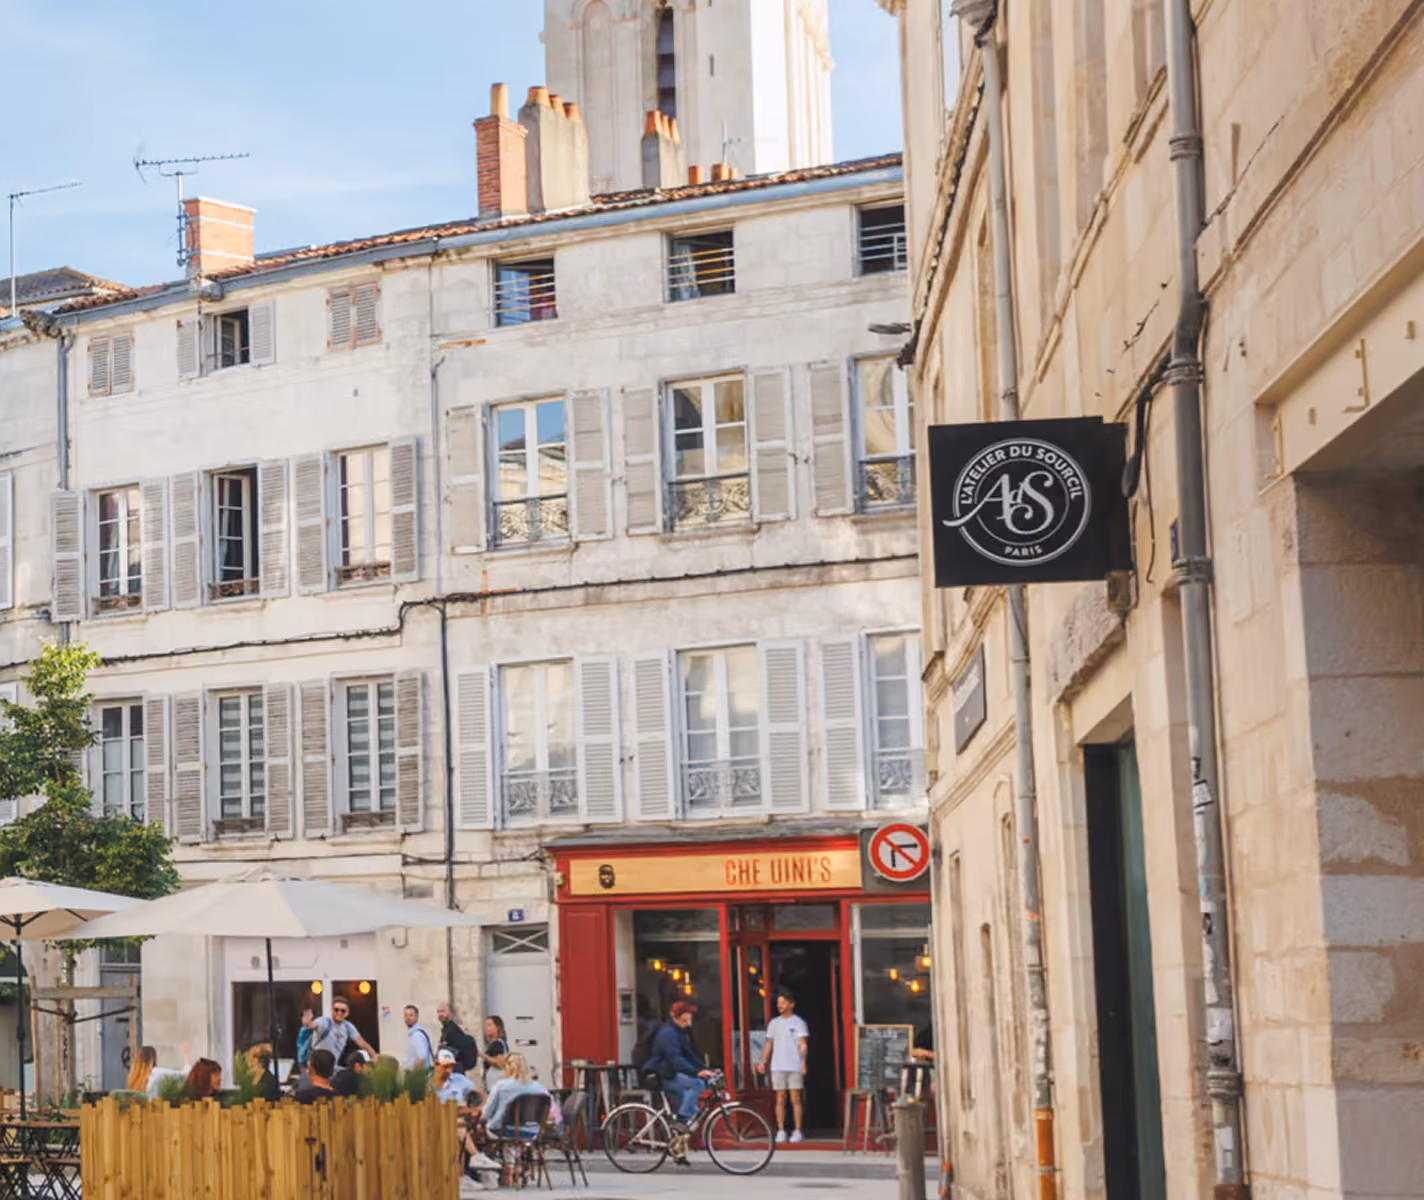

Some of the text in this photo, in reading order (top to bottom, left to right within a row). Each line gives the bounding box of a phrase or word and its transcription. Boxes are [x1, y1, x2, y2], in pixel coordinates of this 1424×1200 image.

[960, 445, 1082, 504] L'ATELIER DU SOURCIL
[1004, 545, 1043, 556] PARIS
[725, 859, 760, 886] CHE
